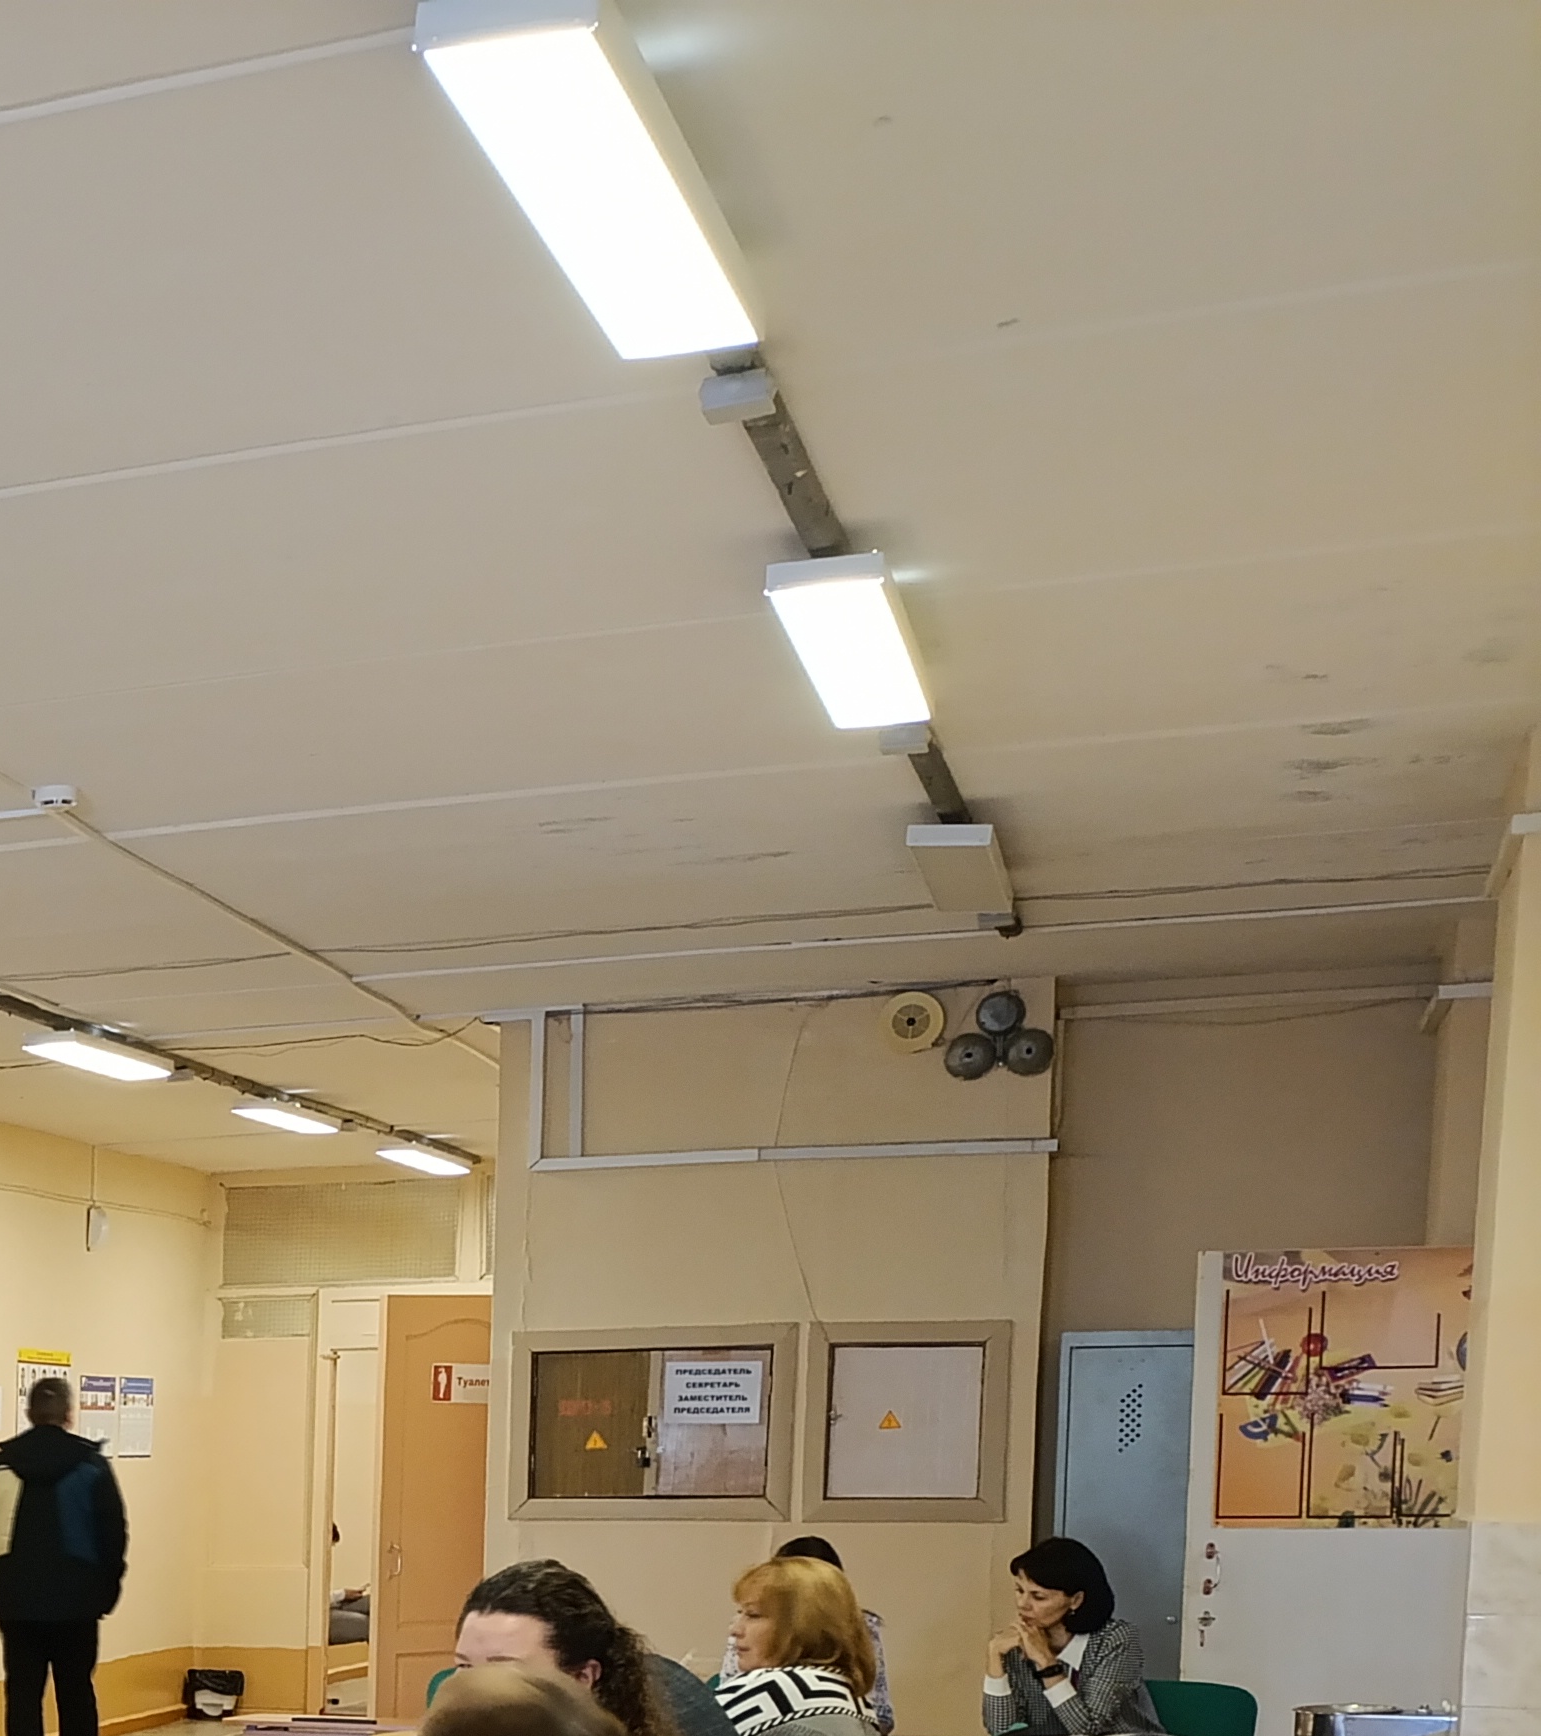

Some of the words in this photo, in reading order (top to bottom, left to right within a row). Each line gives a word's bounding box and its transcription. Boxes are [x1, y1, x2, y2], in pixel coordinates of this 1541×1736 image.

[1233, 1253, 1398, 1288] Информация
[675, 1368, 752, 1376] ПРЕДСЕДАТЕЛЬ
[685, 1380, 741, 1389] СЕКРЕТАРЬ
[677, 1394, 748, 1403] ЗАМЕСТИТЕЛЬ
[673, 1407, 751, 1415] ПРЕДСЕДАТЕЛЯ
